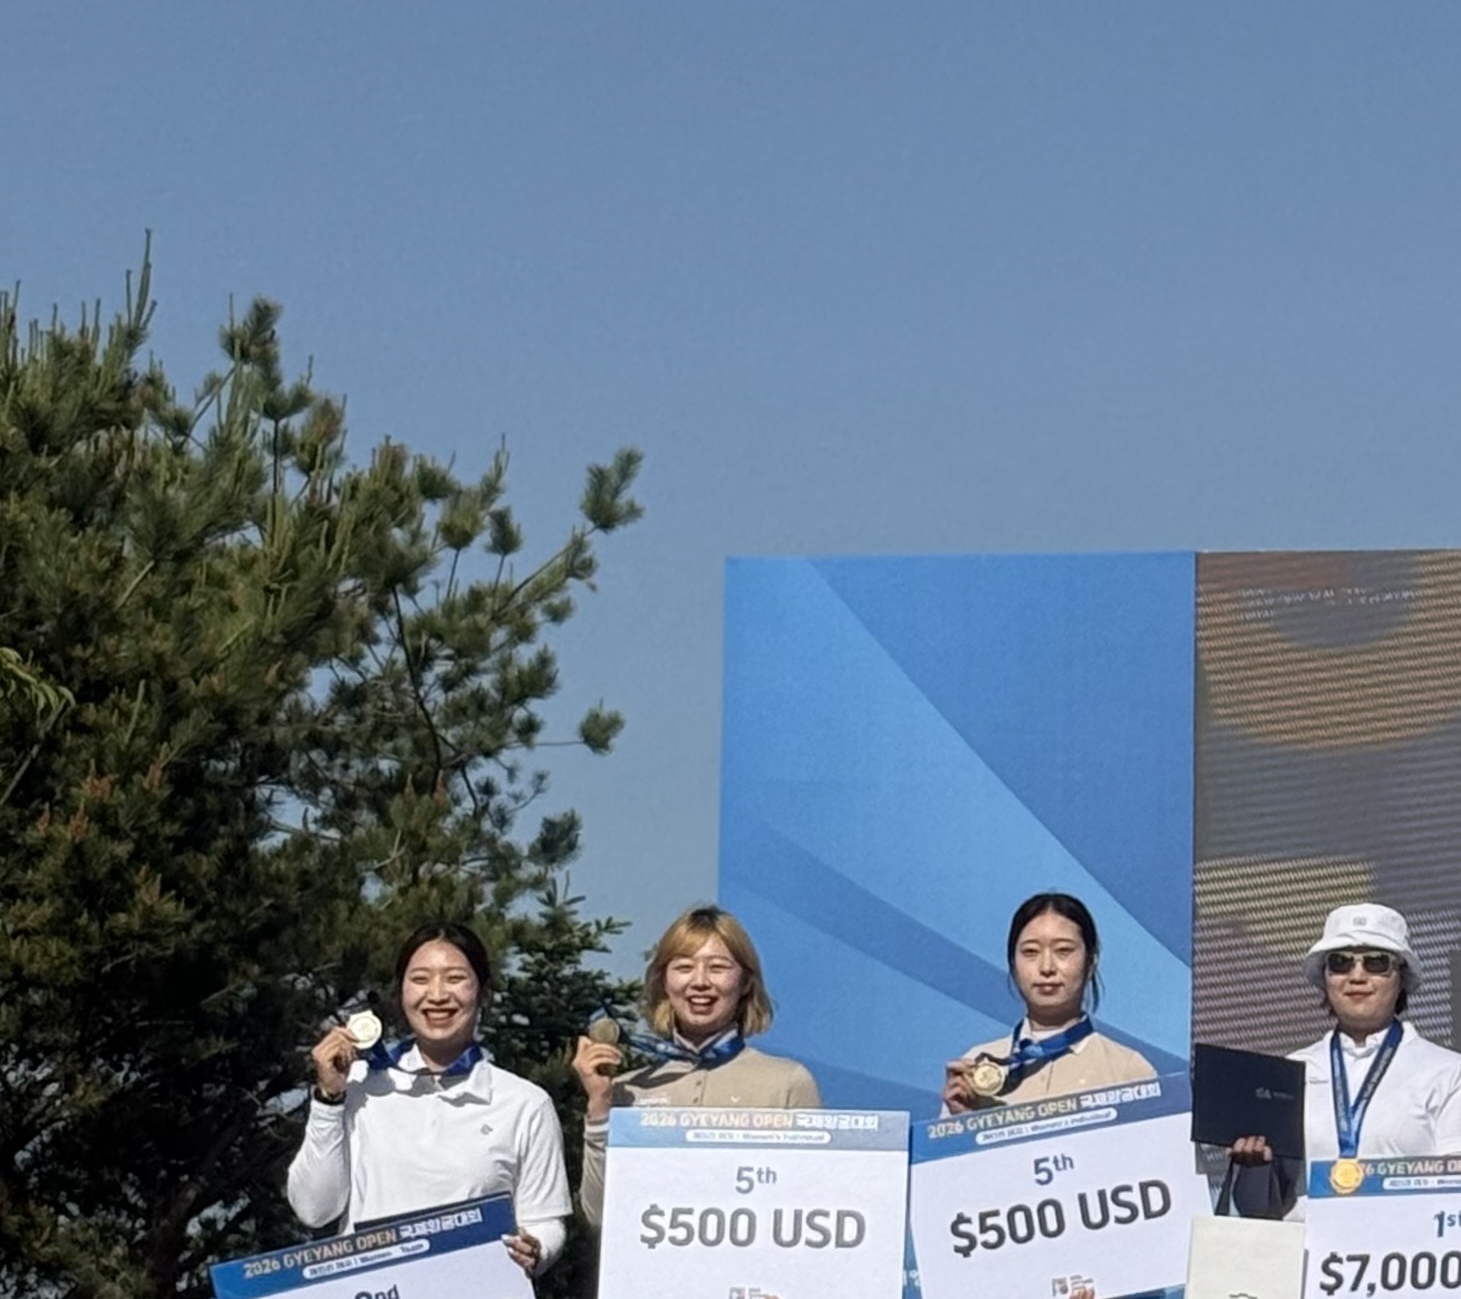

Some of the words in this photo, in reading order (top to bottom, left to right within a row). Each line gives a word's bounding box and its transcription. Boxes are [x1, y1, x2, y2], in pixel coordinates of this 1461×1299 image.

[640, 1113, 678, 1127] 2026
[680, 1112, 749, 1128] GYEYANG
[753, 1113, 793, 1128] OPEN
[928, 1122, 964, 1139] 2026
[966, 1107, 1035, 1132] GYEYANG
[1038, 1099, 1077, 1117] OPEN
[735, 1166, 777, 1195] 5th
[1033, 1153, 1074, 1186] 5th
[1377, 1159, 1444, 1175] GYEYANG
[640, 1203, 757, 1249] $500
[772, 1208, 866, 1249] USD
[950, 1198, 1066, 1258] $500
[1077, 1179, 1172, 1230] USD
[243, 1259, 281, 1278] 2026
[284, 1240, 353, 1269] GYEYANG
[356, 1229, 398, 1251] OPEN
